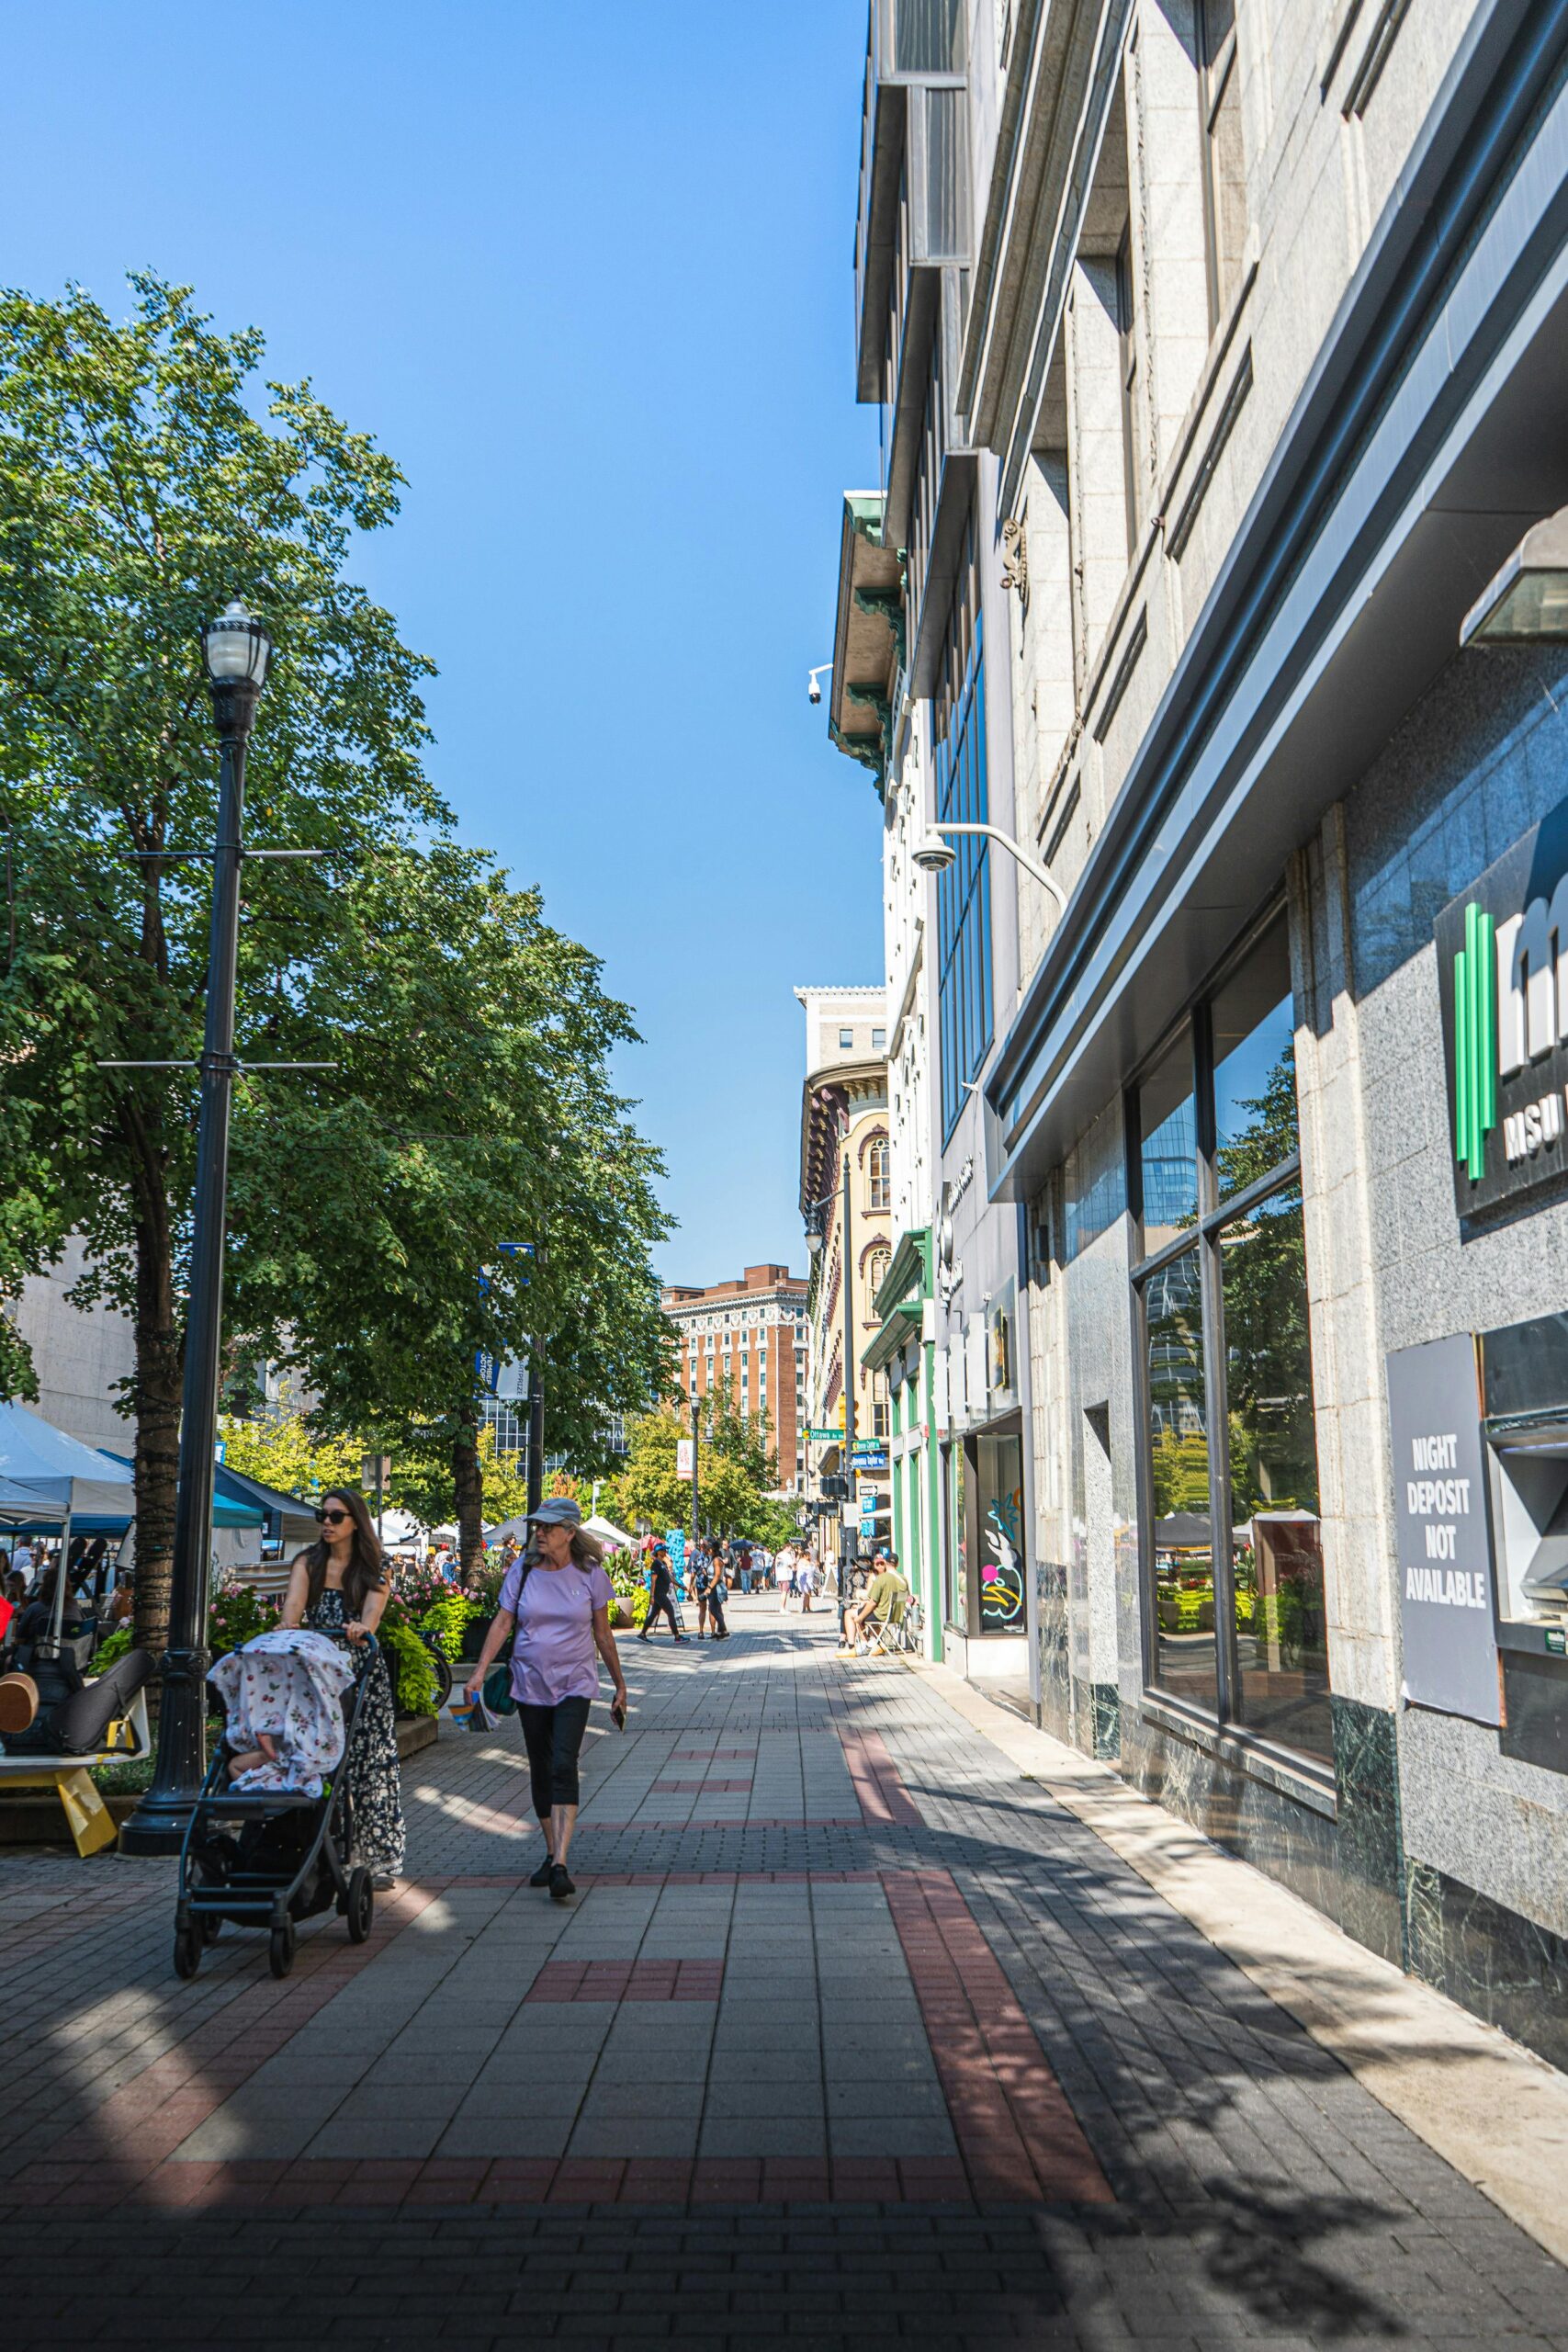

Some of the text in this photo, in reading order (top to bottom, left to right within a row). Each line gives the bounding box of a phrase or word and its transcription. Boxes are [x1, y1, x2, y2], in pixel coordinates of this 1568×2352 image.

[1503, 1093, 1561, 1160] MSU
[810, 1430, 830, 1439] Ottawa
[1412, 1433, 1457, 1471] NIGHT
[1406, 1478, 1470, 1516] DEPOSIT
[1425, 1523, 1457, 1560] NOT
[1405, 1566, 1487, 1610] AVAILABLE
